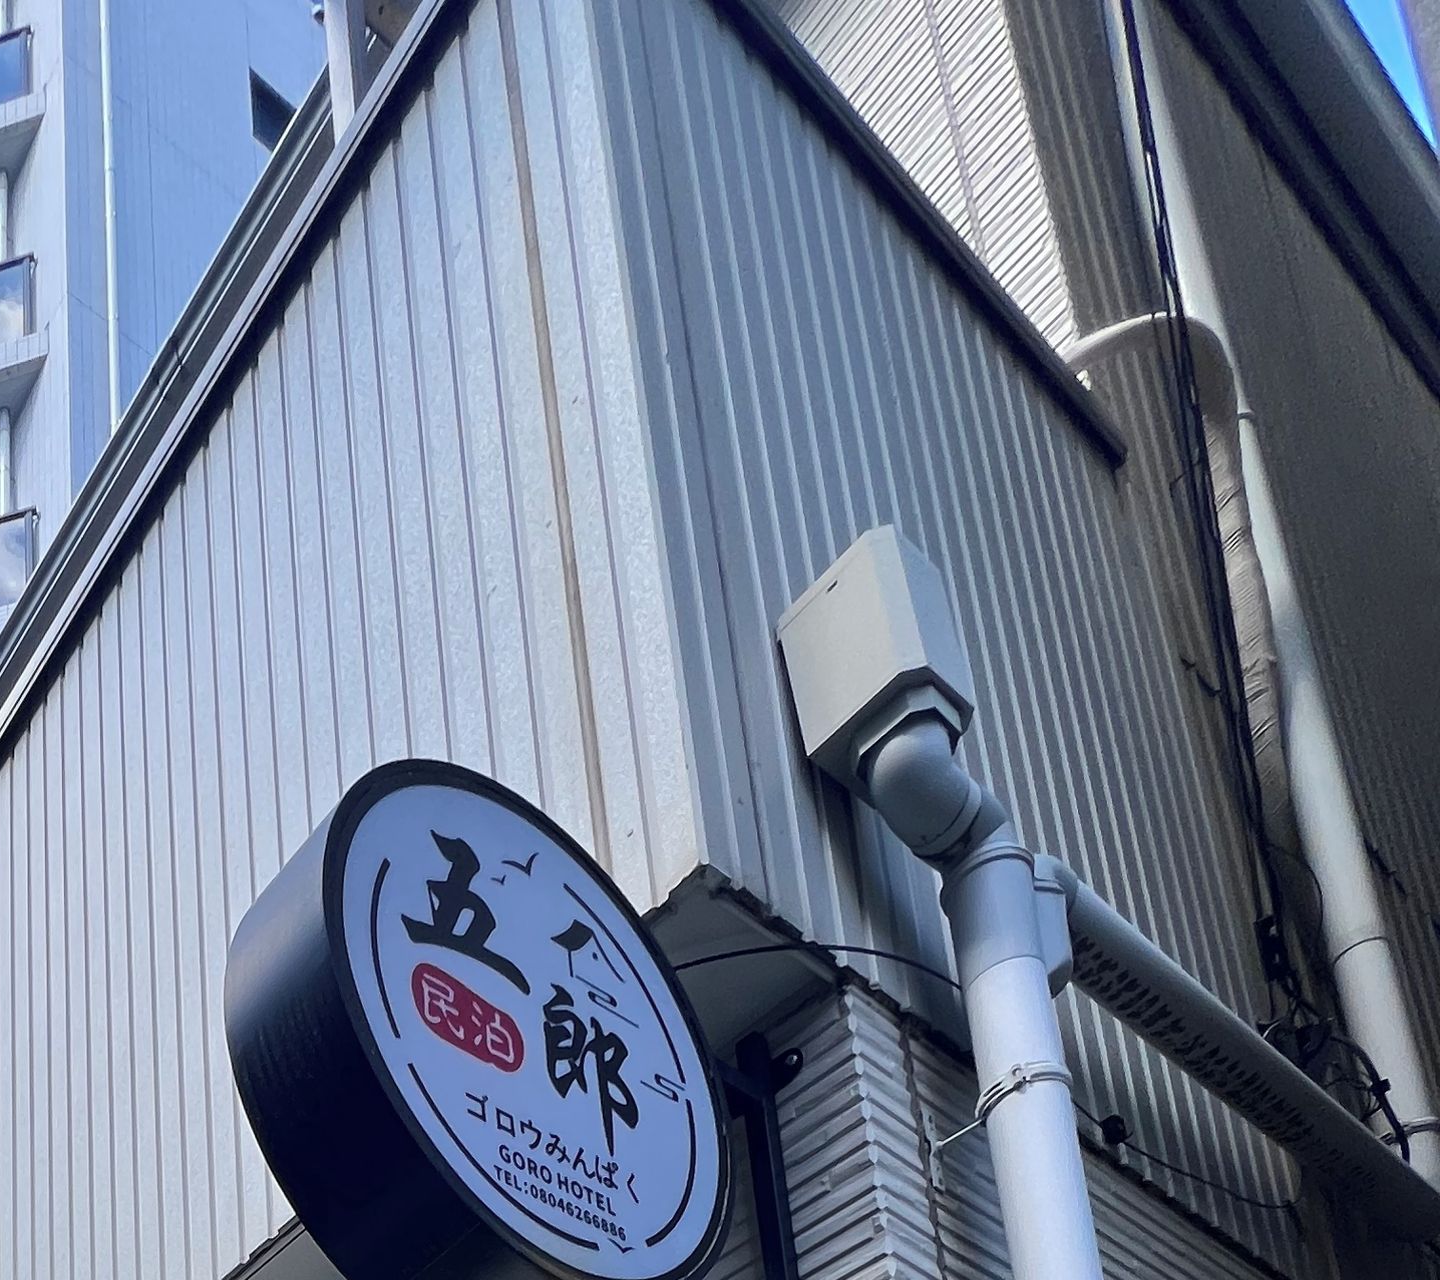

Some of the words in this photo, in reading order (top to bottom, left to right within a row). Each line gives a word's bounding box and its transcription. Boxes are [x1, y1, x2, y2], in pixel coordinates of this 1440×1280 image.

[422, 973, 515, 1064] 民泊
[465, 1091, 640, 1204] ゴロウみんぱく
[498, 1144, 552, 1185] GORO
[557, 1172, 617, 1217] HOTEL
